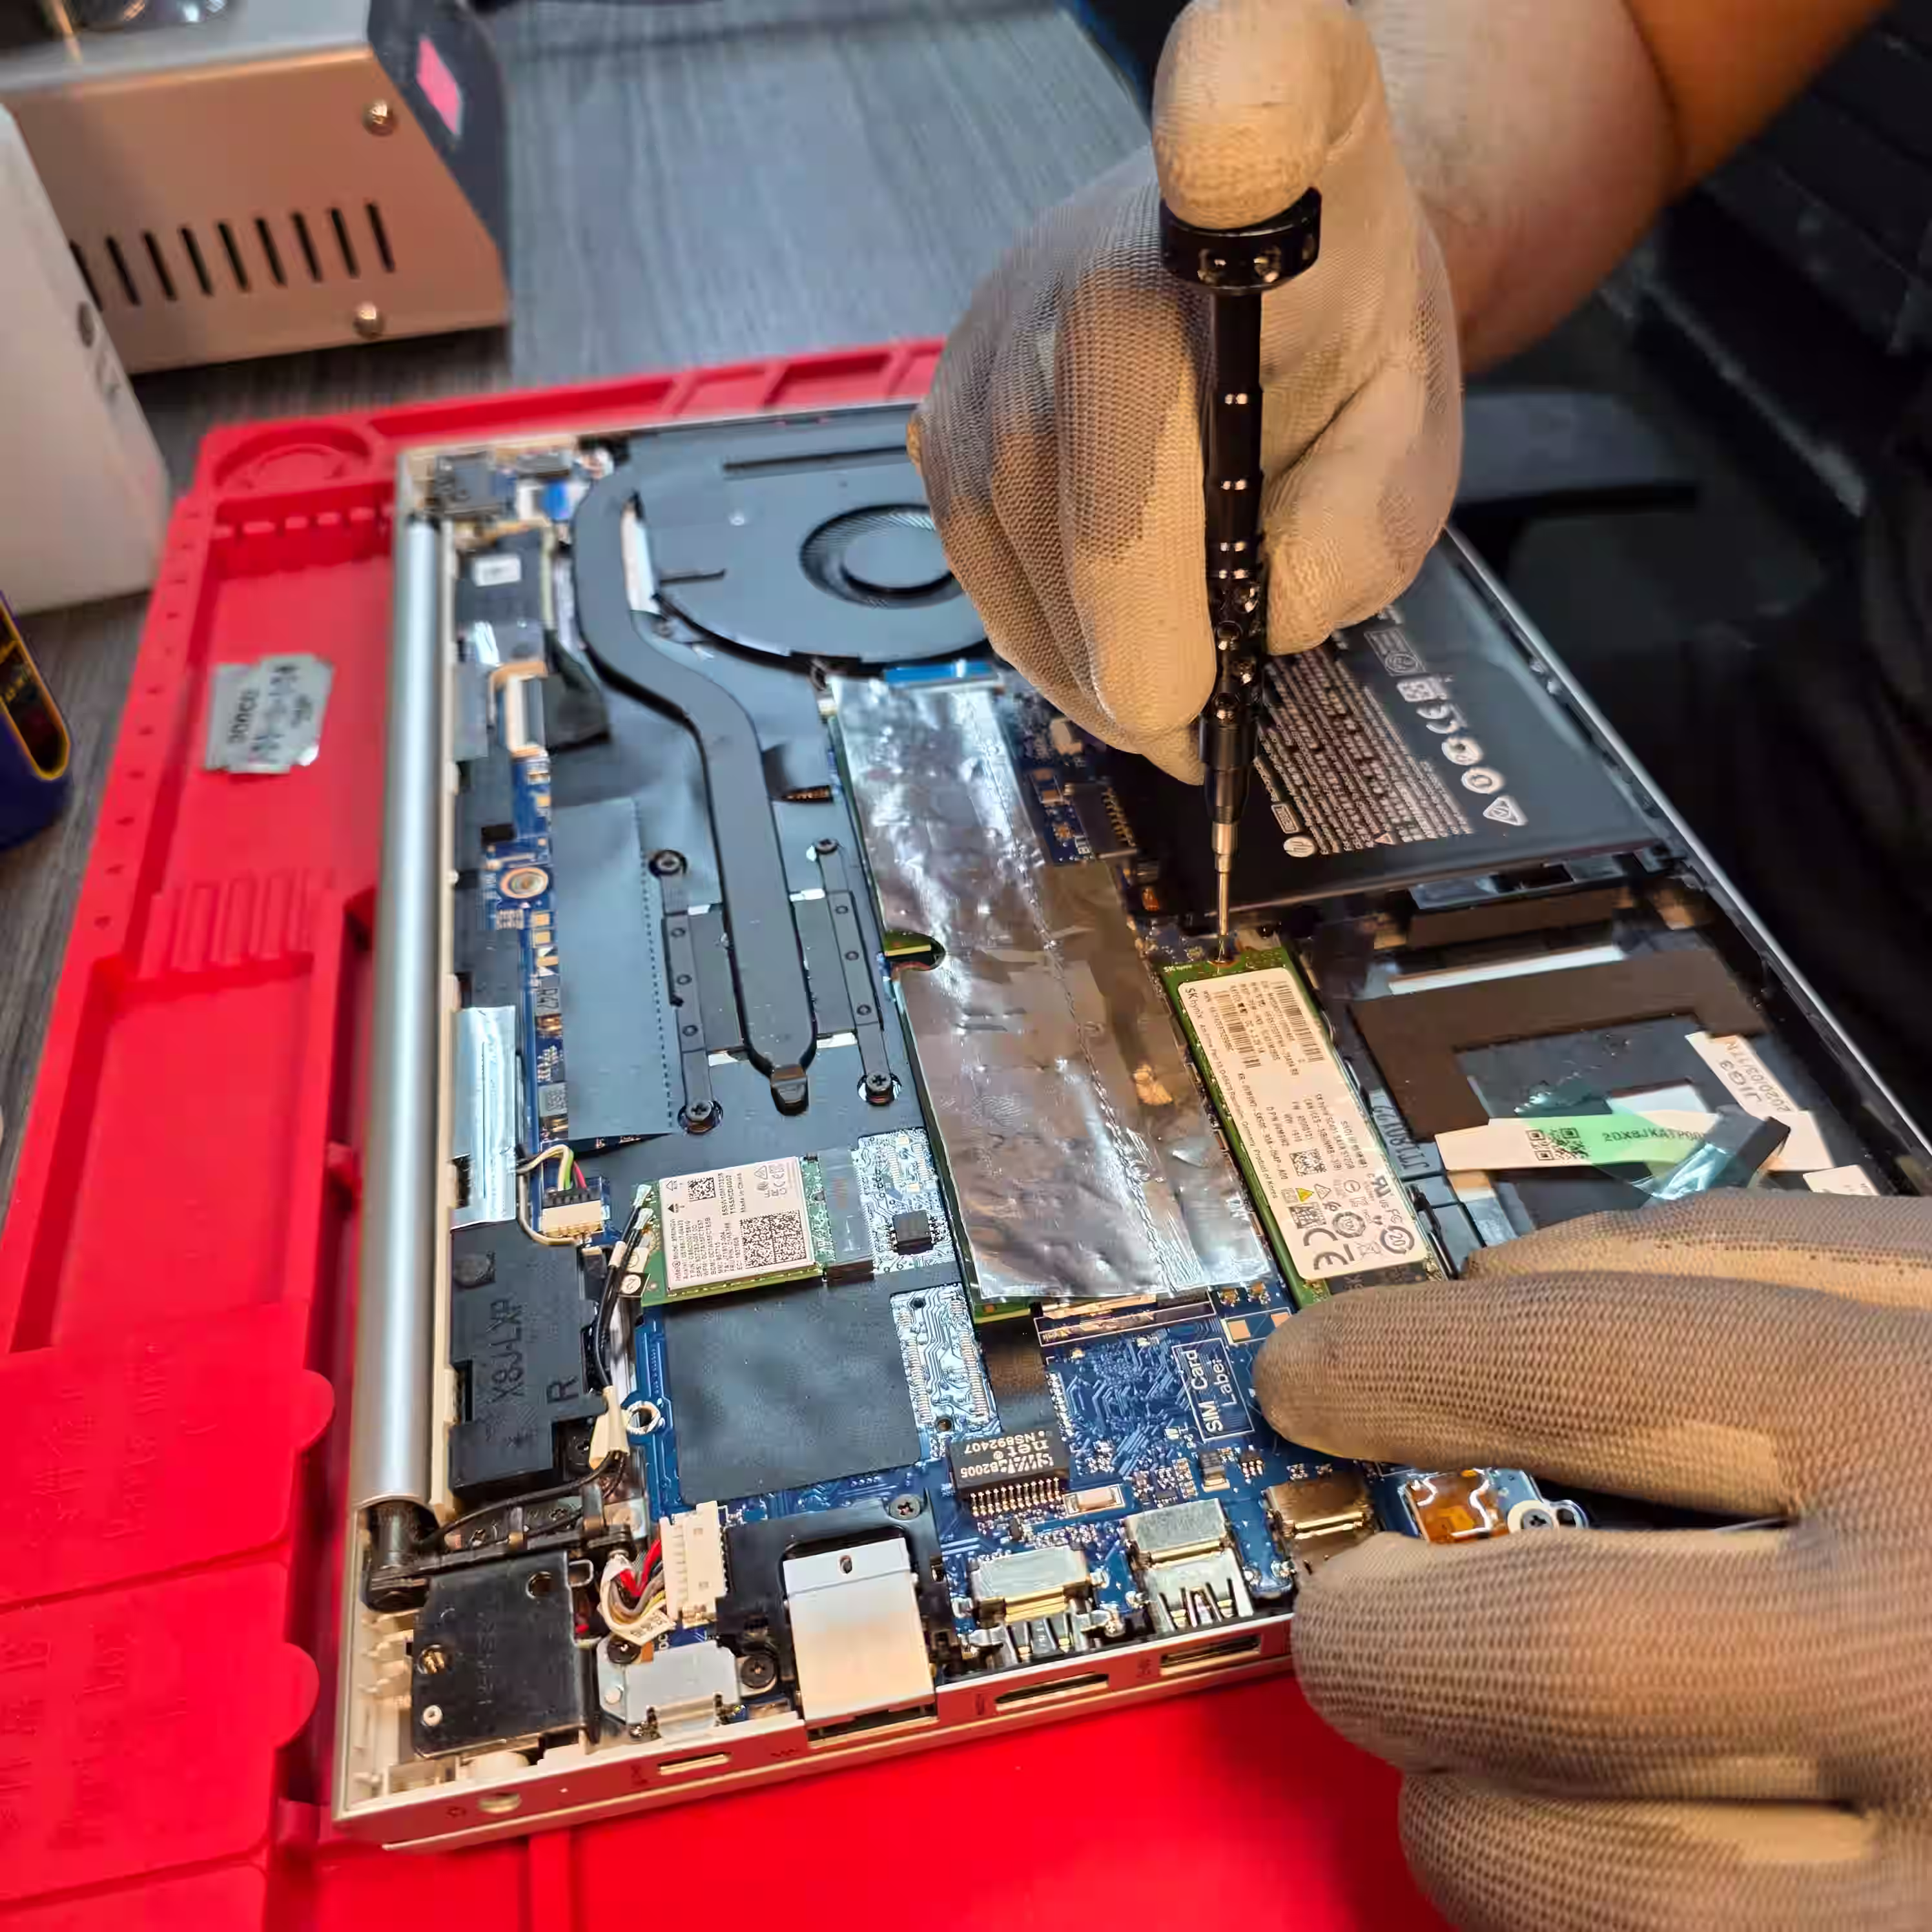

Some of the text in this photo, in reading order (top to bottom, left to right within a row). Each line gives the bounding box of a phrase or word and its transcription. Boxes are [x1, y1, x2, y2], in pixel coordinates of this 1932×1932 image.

[1184, 987, 1198, 1000] SK
[1187, 999, 1206, 1020] hynix
[1251, 1148, 1269, 1173] Product
[1265, 1180, 1280, 1199] Korea
[1388, 1231, 1407, 1247] 20
[547, 1374, 579, 1403] R
[1179, 1348, 1225, 1434] SIM Card
[964, 1432, 1036, 1454] NS892407
